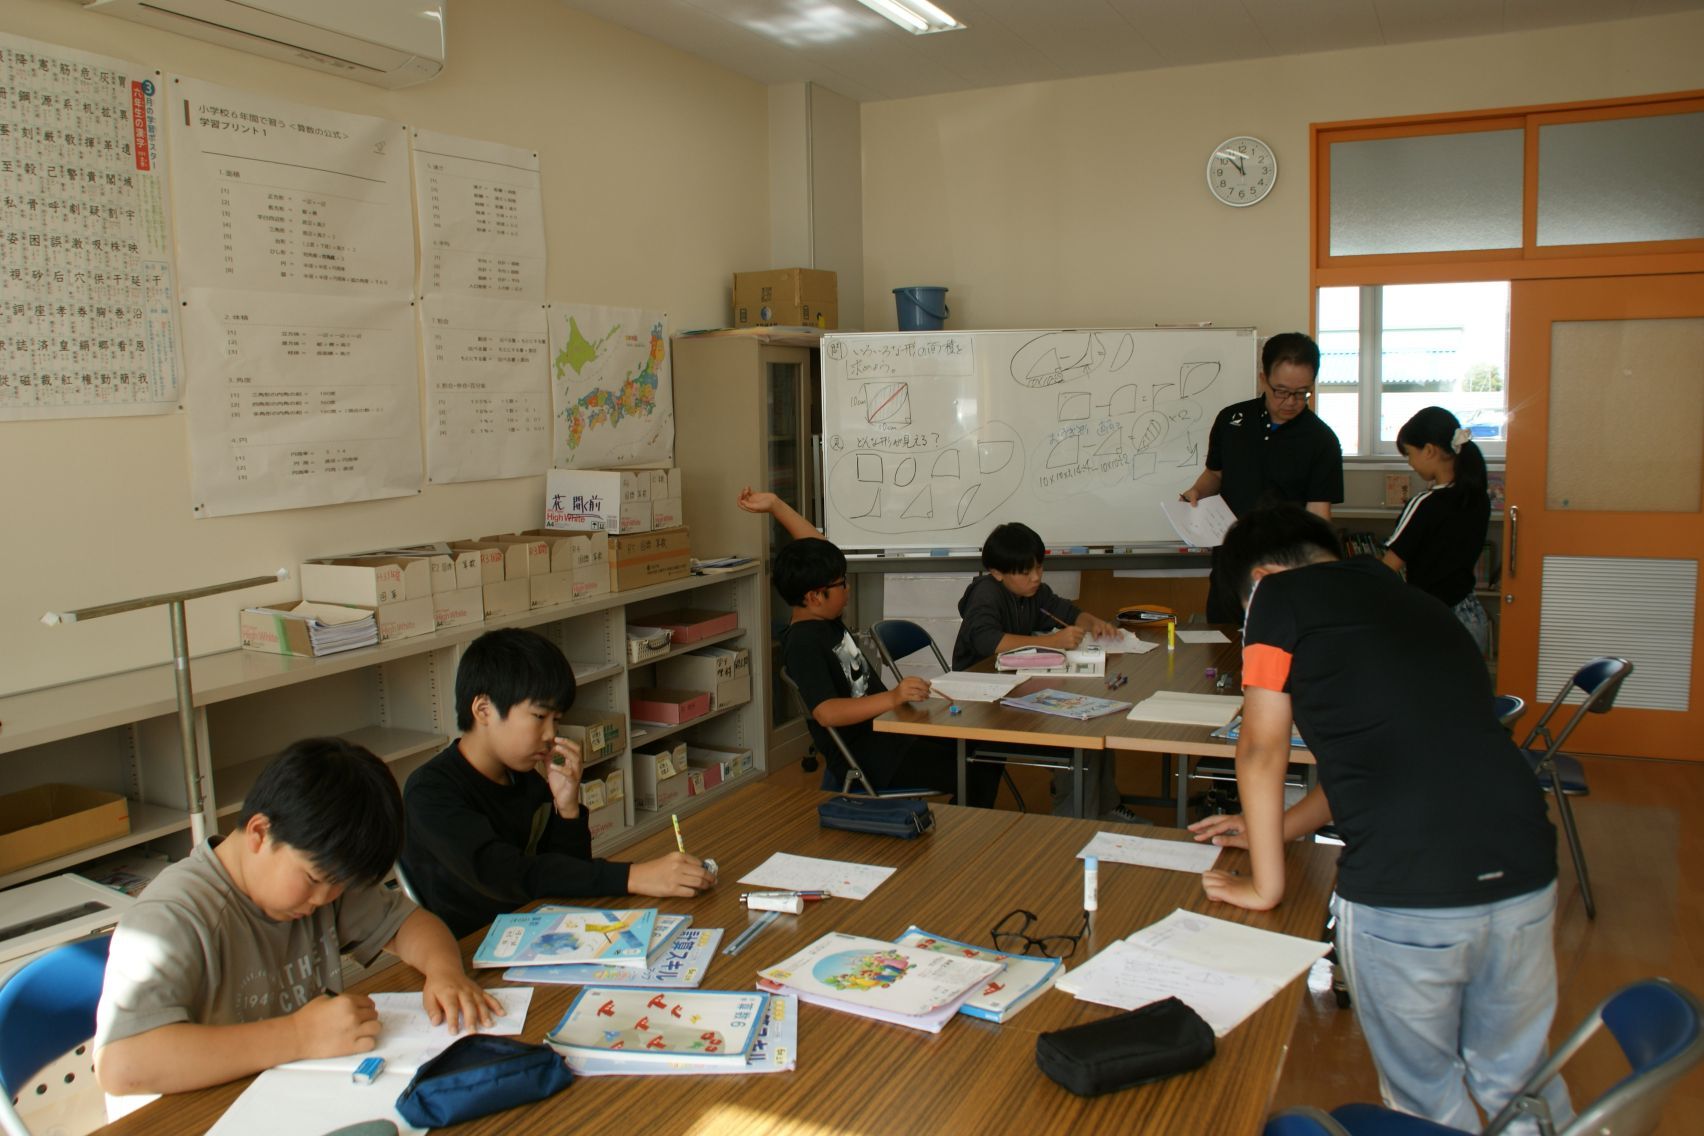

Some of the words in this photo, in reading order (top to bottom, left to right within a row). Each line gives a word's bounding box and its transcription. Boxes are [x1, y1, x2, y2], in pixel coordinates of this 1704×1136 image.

[1238, 145, 1247, 154] 12
[1252, 148, 1255, 156] 1
[1258, 156, 1264, 164] 2
[1217, 168, 1223, 176] 9
[1262, 167, 1268, 175] 3
[1220, 180, 1226, 188] 8
[1257, 178, 1264, 186] 4
[1238, 190, 1245, 198] 6
[1250, 186, 1256, 194] 5
